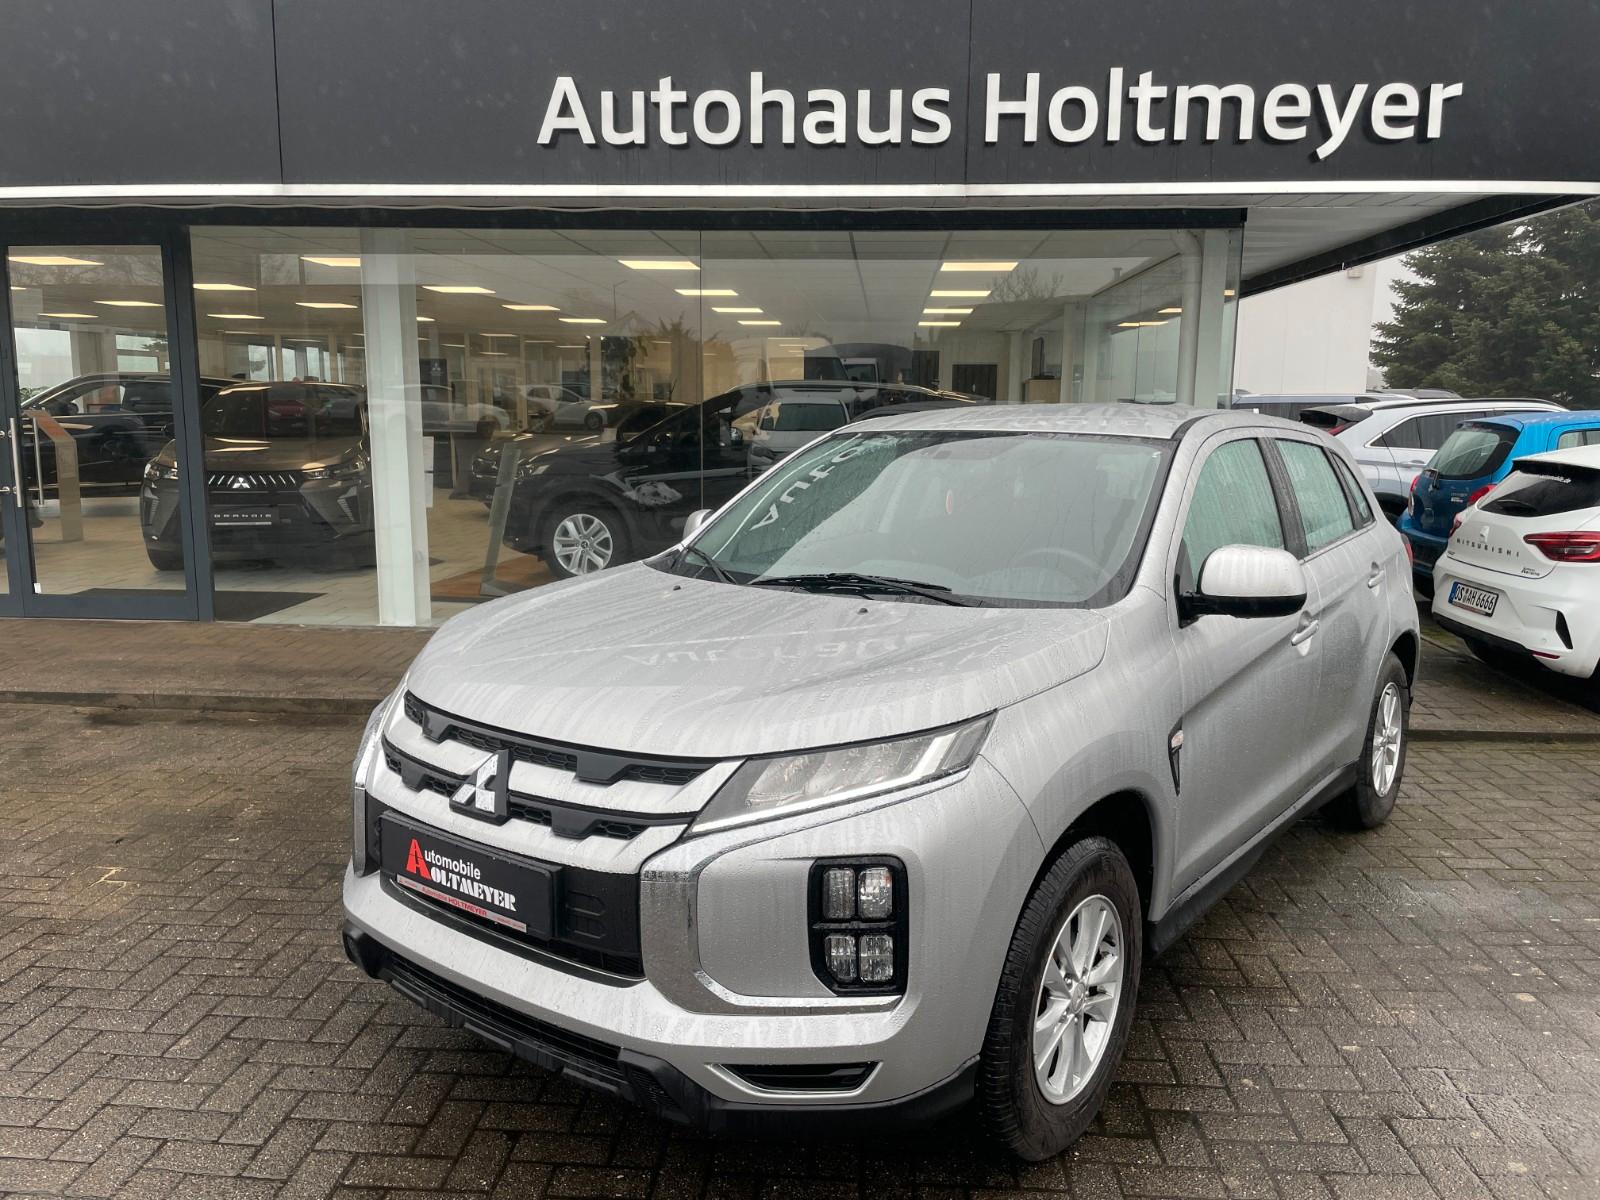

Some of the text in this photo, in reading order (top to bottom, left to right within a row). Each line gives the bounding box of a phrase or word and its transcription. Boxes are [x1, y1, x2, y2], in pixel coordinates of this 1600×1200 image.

[537, 66, 1464, 160] Autohaus Holtmeyer
[1456, 538, 1520, 558] MITSUBISHI
[1475, 593, 1495, 611] 6666
[448, 897, 487, 916] HOLTMEYER
